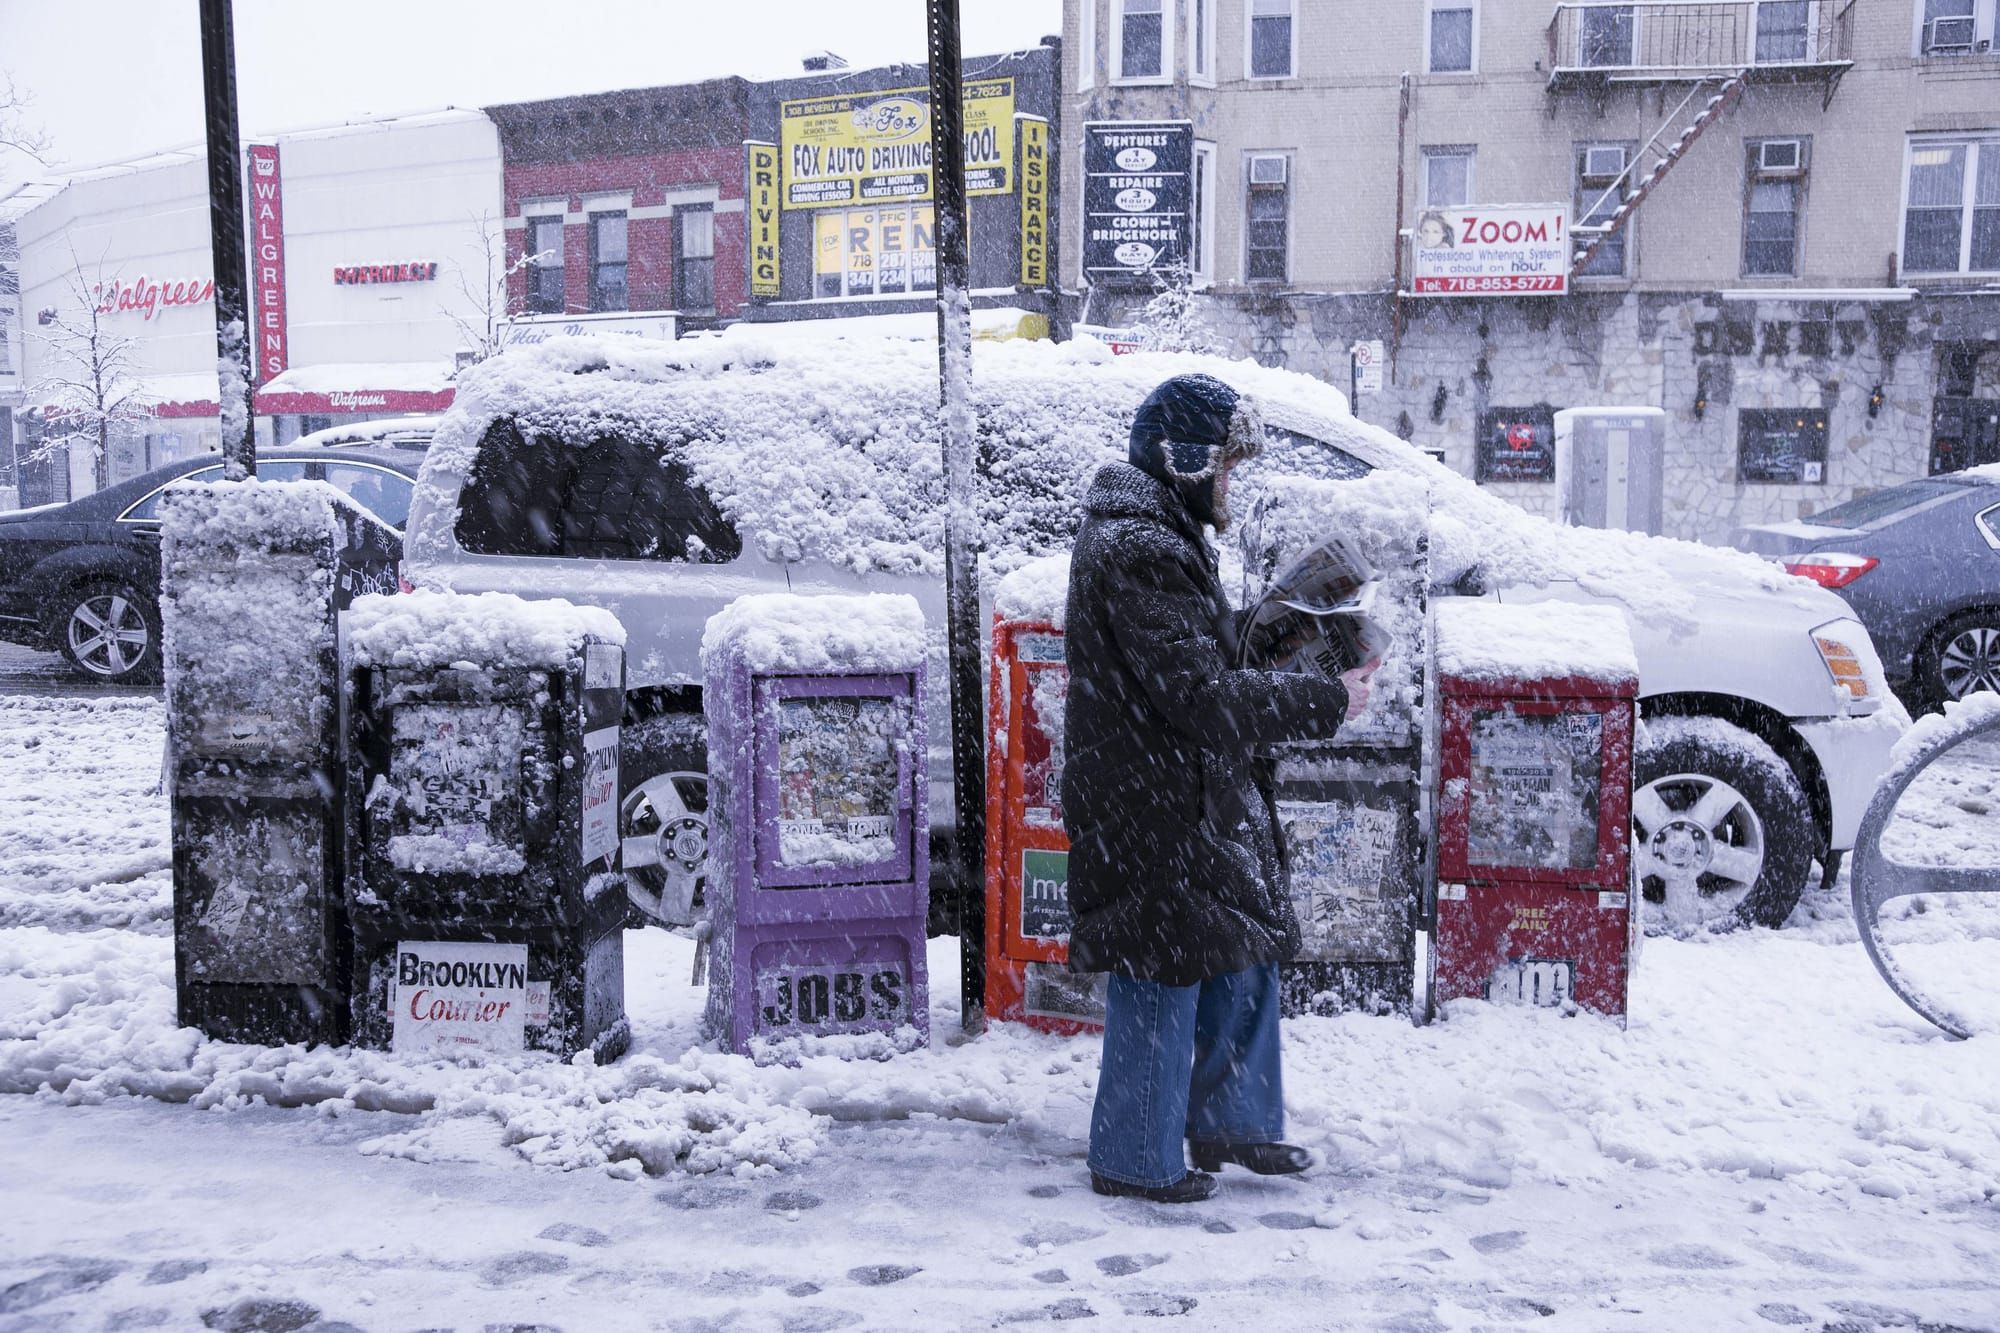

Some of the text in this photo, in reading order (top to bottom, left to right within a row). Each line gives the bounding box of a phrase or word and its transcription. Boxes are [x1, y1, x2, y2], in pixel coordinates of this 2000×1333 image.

[876, 106, 916, 131] Fox
[1104, 135, 1168, 147] DENTURES
[793, 143, 820, 177] FOX
[827, 146, 865, 175] AUTO
[872, 141, 932, 170] DRIVING
[792, 180, 851, 193] COMMERCIAL CDL
[873, 175, 914, 186] ALL MOTOR
[792, 190, 851, 203] DRIVING LESSONS
[863, 184, 926, 198] VEHICLE SERVICES
[1026, 127, 1042, 280] INSURANCE
[756, 152, 774, 280] DRIVING
[864, 211, 920, 223] OFFICE
[823, 223, 935, 253] FOR REN
[1093, 229, 1178, 241] BRIDGEWORK
[1131, 244, 1140, 252] 5
[1420, 249, 1562, 263] Professional Whitening System
[853, 254, 871, 267] 718
[1450, 263, 1483, 273] about
[1511, 261, 1547, 273] hour.
[256, 183, 282, 373] WALGREENS
[334, 262, 437, 285] PHARMACY
[849, 272, 874, 287] 347
[881, 269, 906, 285] 234
[1422, 276, 1558, 291] Tel: 718-853-5777
[94, 276, 214, 320] Walgreen
[329, 391, 387, 411] Walgreens
[1807, 465, 1818, 478] A
[583, 744, 617, 777] BRKLYN
[1515, 908, 1547, 919] FREE
[399, 952, 524, 989] BROOKLYN
[411, 989, 511, 1022] Courier
[762, 970, 901, 1026] JOBS
